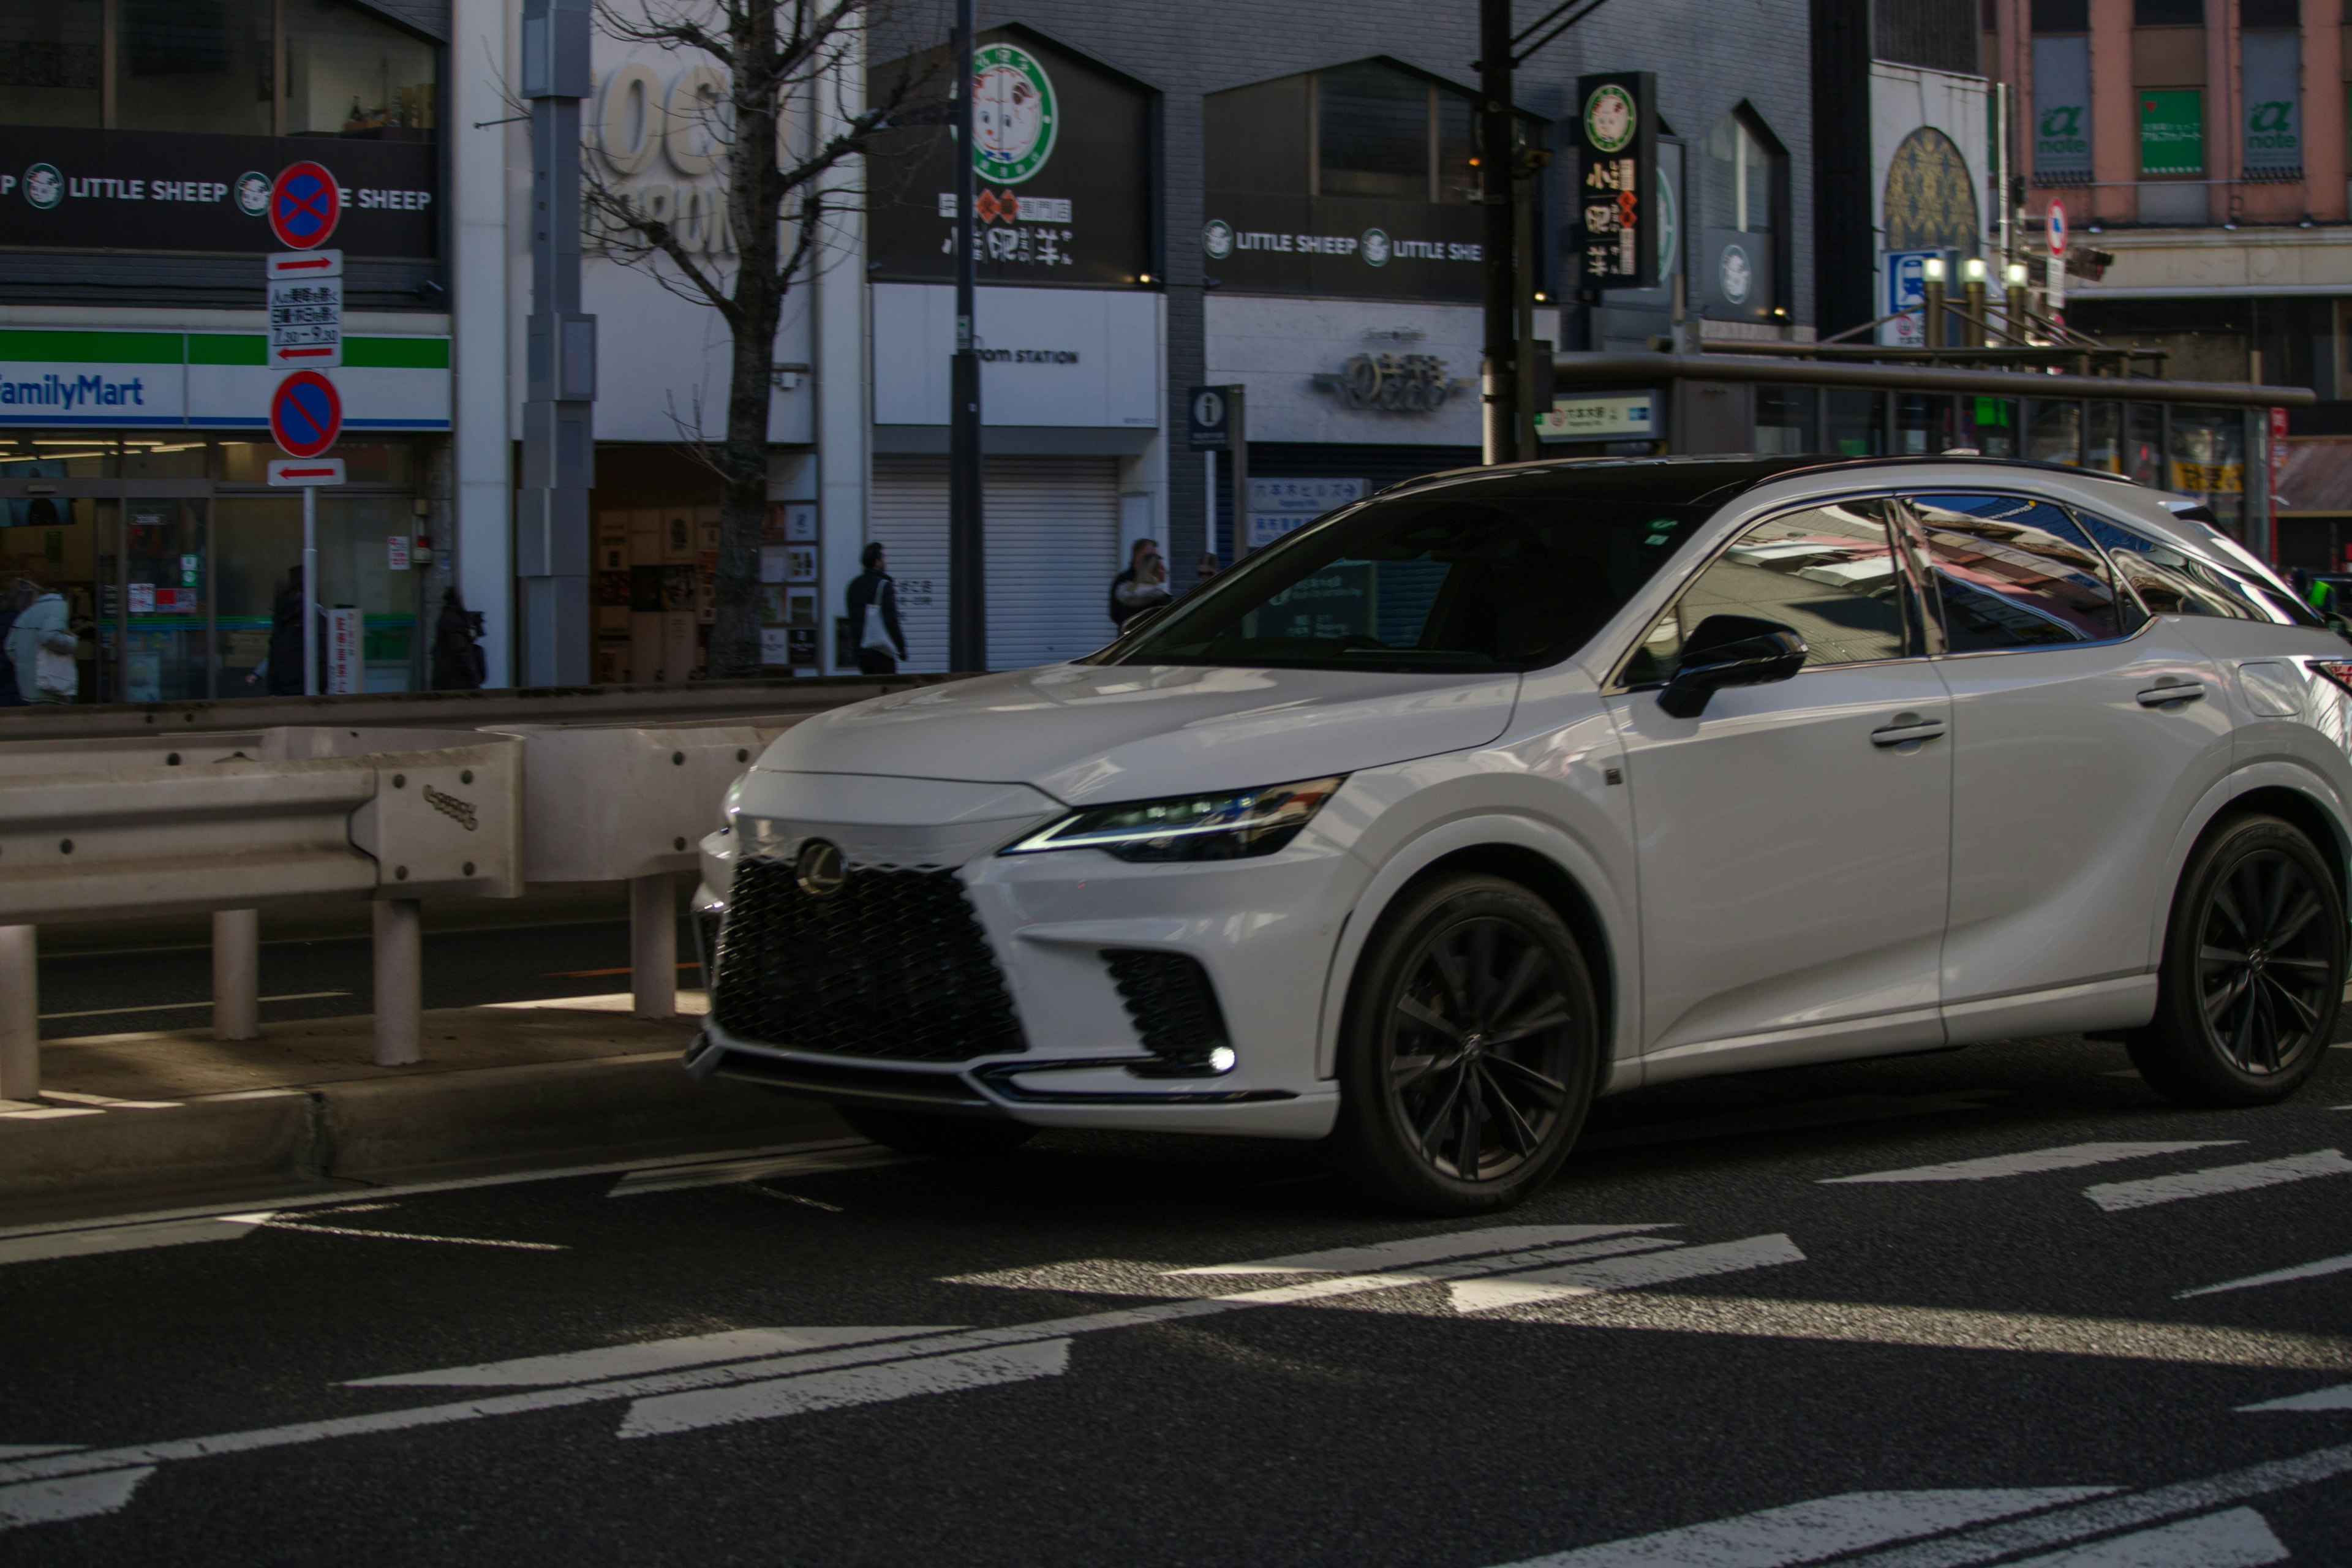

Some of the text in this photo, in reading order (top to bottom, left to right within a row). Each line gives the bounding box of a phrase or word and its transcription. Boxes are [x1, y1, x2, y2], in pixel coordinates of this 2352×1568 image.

[2039, 138, 2087, 153] note
[2248, 133, 2297, 149] note
[69, 177, 228, 203] LITTLE SHEEP
[358, 188, 432, 211] SHEEP
[1236, 232, 1358, 255] LITTLE SHEEP
[1393, 240, 1446, 260] LITTLE
[1016, 349, 1079, 364] STATION
[0, 374, 144, 410] amilyMart
